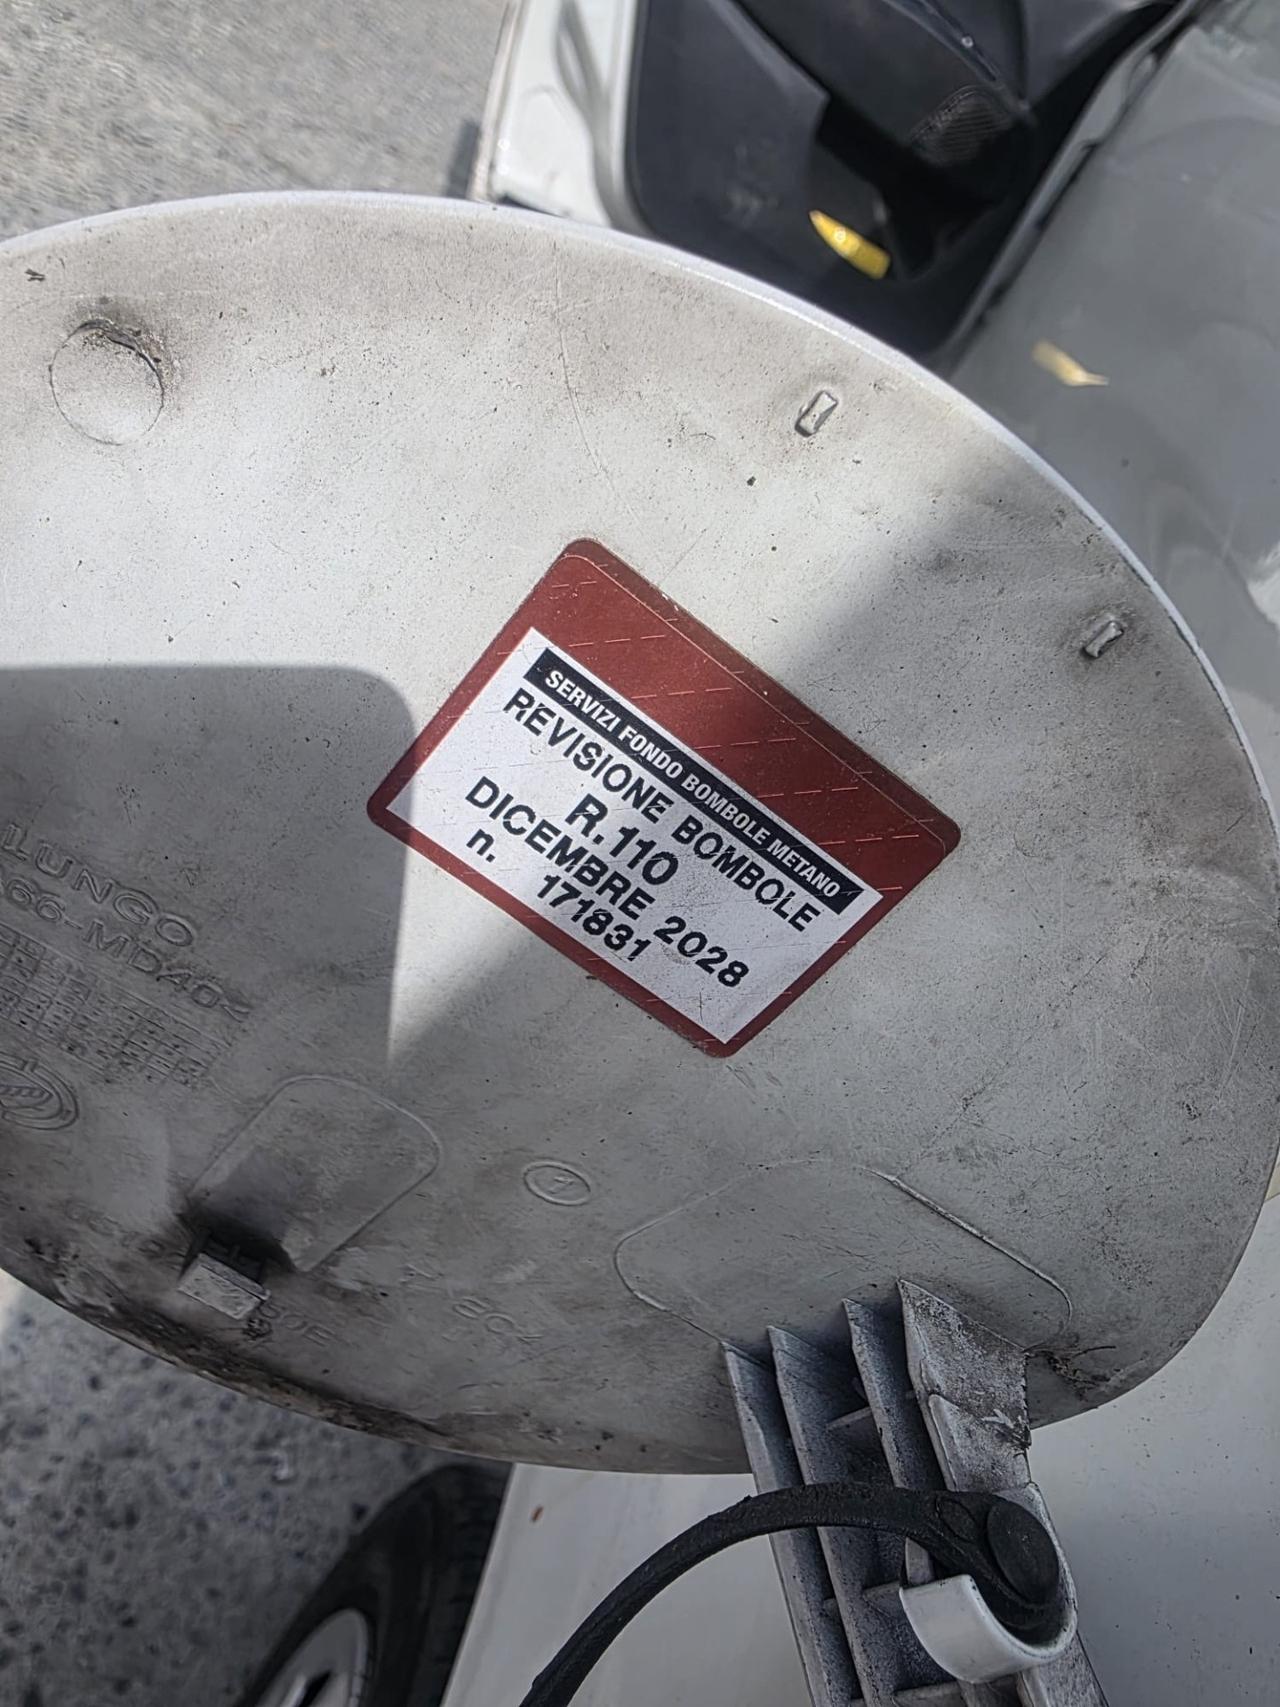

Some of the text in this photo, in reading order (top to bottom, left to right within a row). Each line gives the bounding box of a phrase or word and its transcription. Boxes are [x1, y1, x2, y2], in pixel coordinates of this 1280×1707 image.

[465, 776, 750, 988] DICEMBRE 2028
[503, 687, 821, 933] REVISIONE BOMBOLE
[544, 669, 841, 898] SERVIZI FONDO BOMBOLE METANO
[564, 793, 679, 886] R.110
[466, 828, 652, 962] n. 171831
